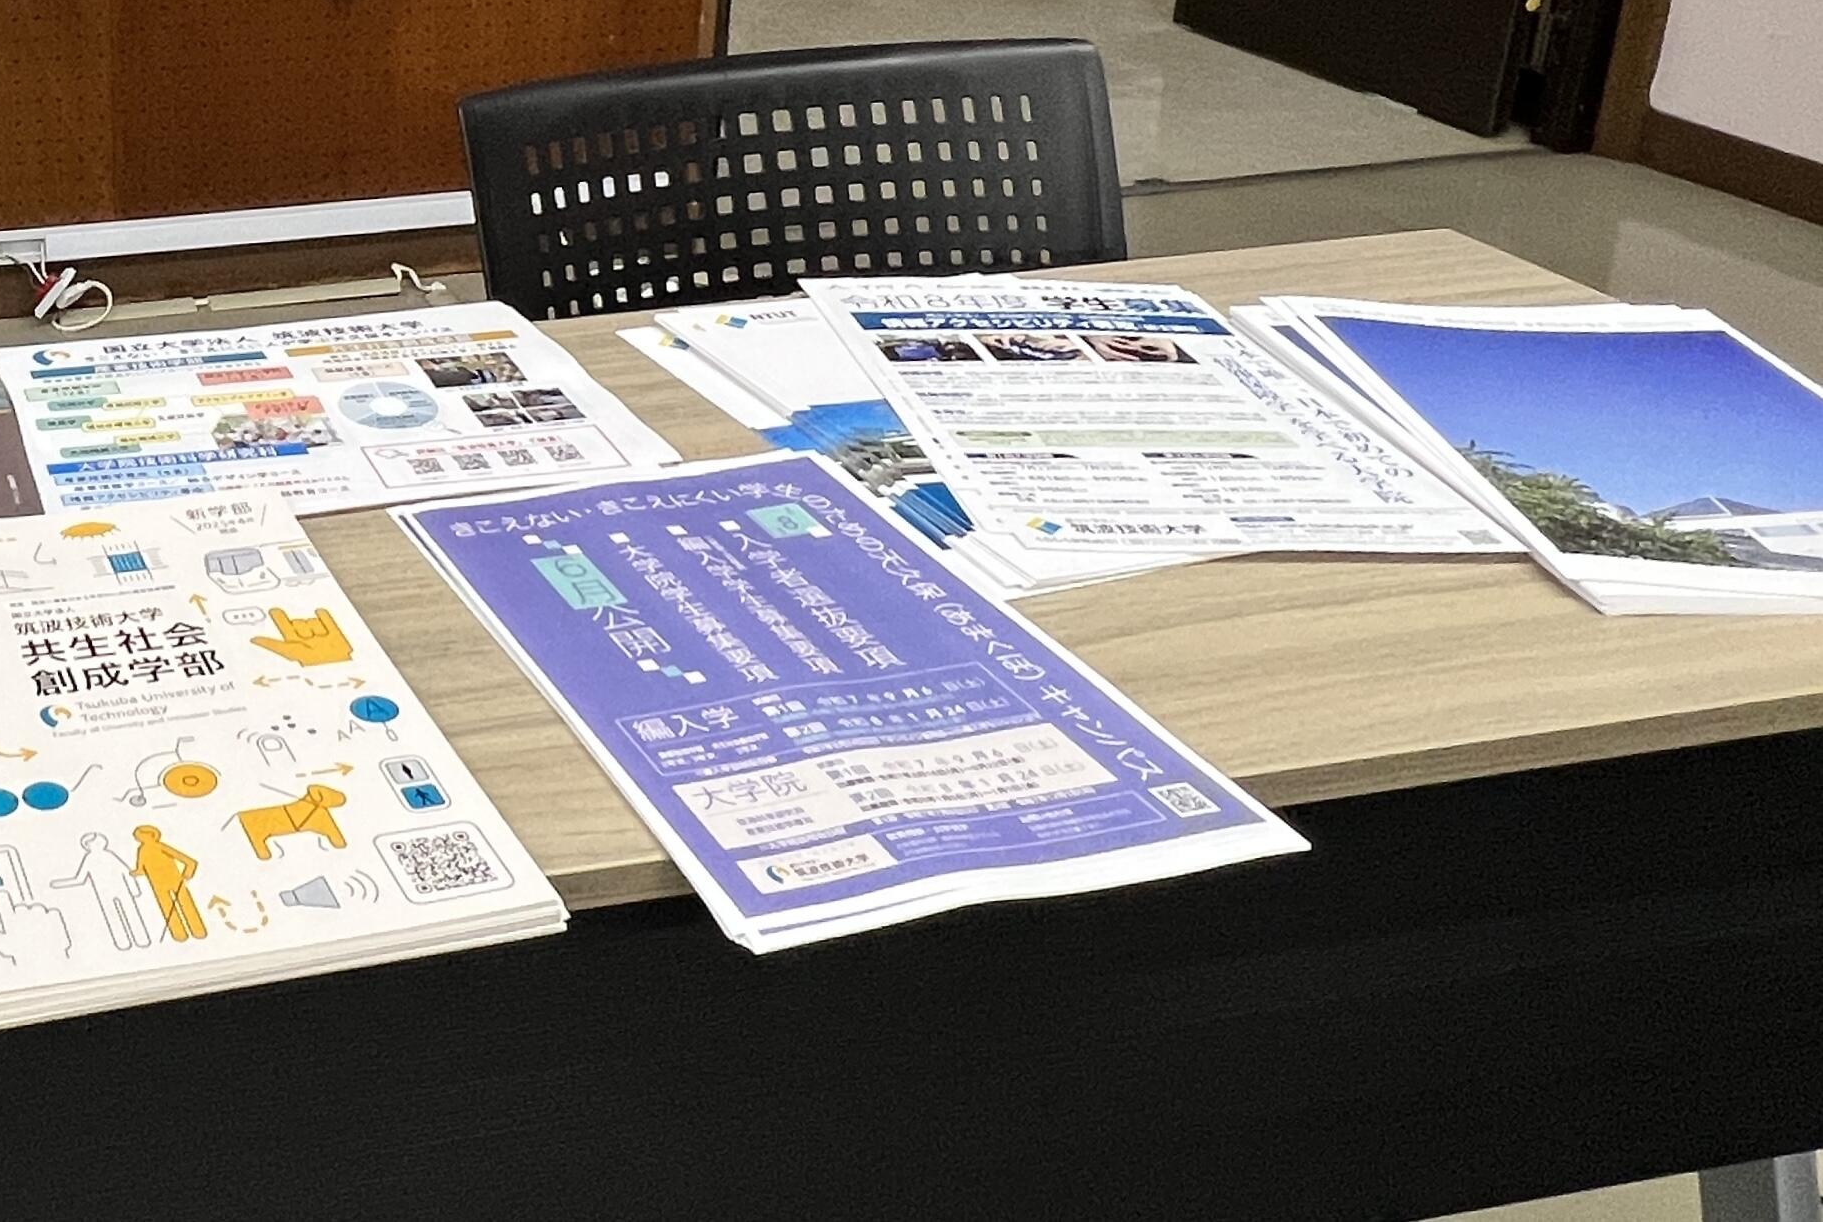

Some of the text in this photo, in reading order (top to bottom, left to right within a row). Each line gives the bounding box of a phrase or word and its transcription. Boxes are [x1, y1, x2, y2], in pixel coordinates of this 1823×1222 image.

[185, 500, 253, 521] 新学部
[1070, 522, 1206, 538] 筑波技術大学
[14, 607, 164, 636] 筑波技術大学
[21, 621, 209, 667] 共生社会
[31, 649, 225, 697] 創成学部
[76, 680, 235, 712] Tsukuba University of
[79, 704, 169, 724] Technology
[631, 704, 740, 742] 編入学
[691, 770, 808, 811] 大学院
